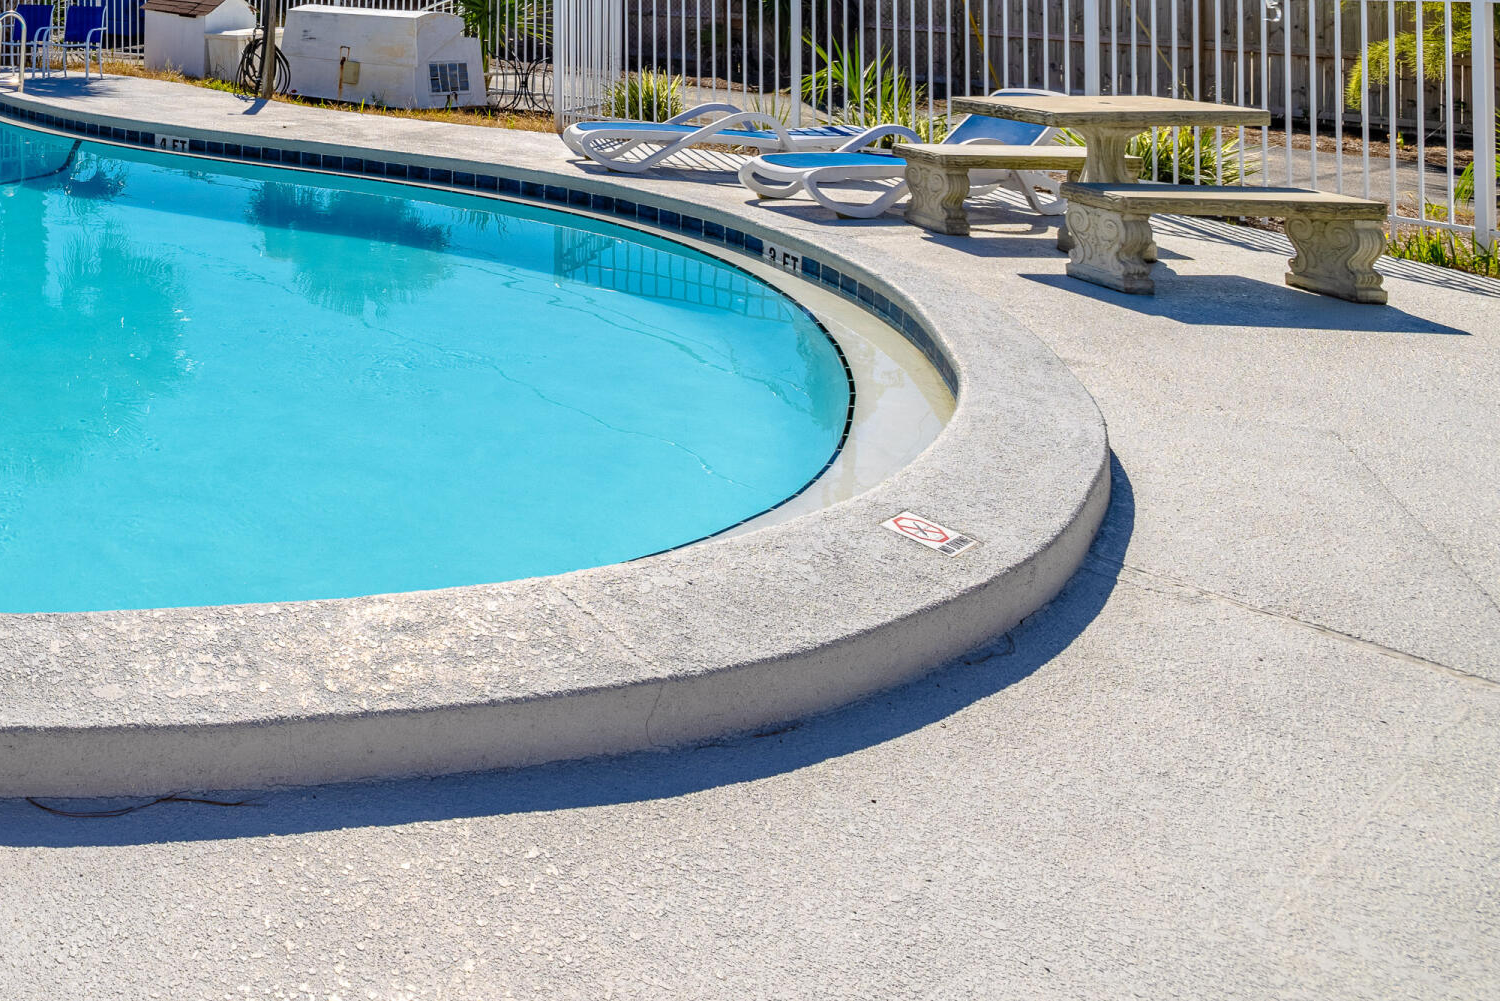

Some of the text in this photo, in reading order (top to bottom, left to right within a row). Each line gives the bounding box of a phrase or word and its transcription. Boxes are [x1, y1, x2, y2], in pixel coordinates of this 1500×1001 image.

[160, 138, 187, 150] 4 FT
[783, 252, 798, 270] FT
